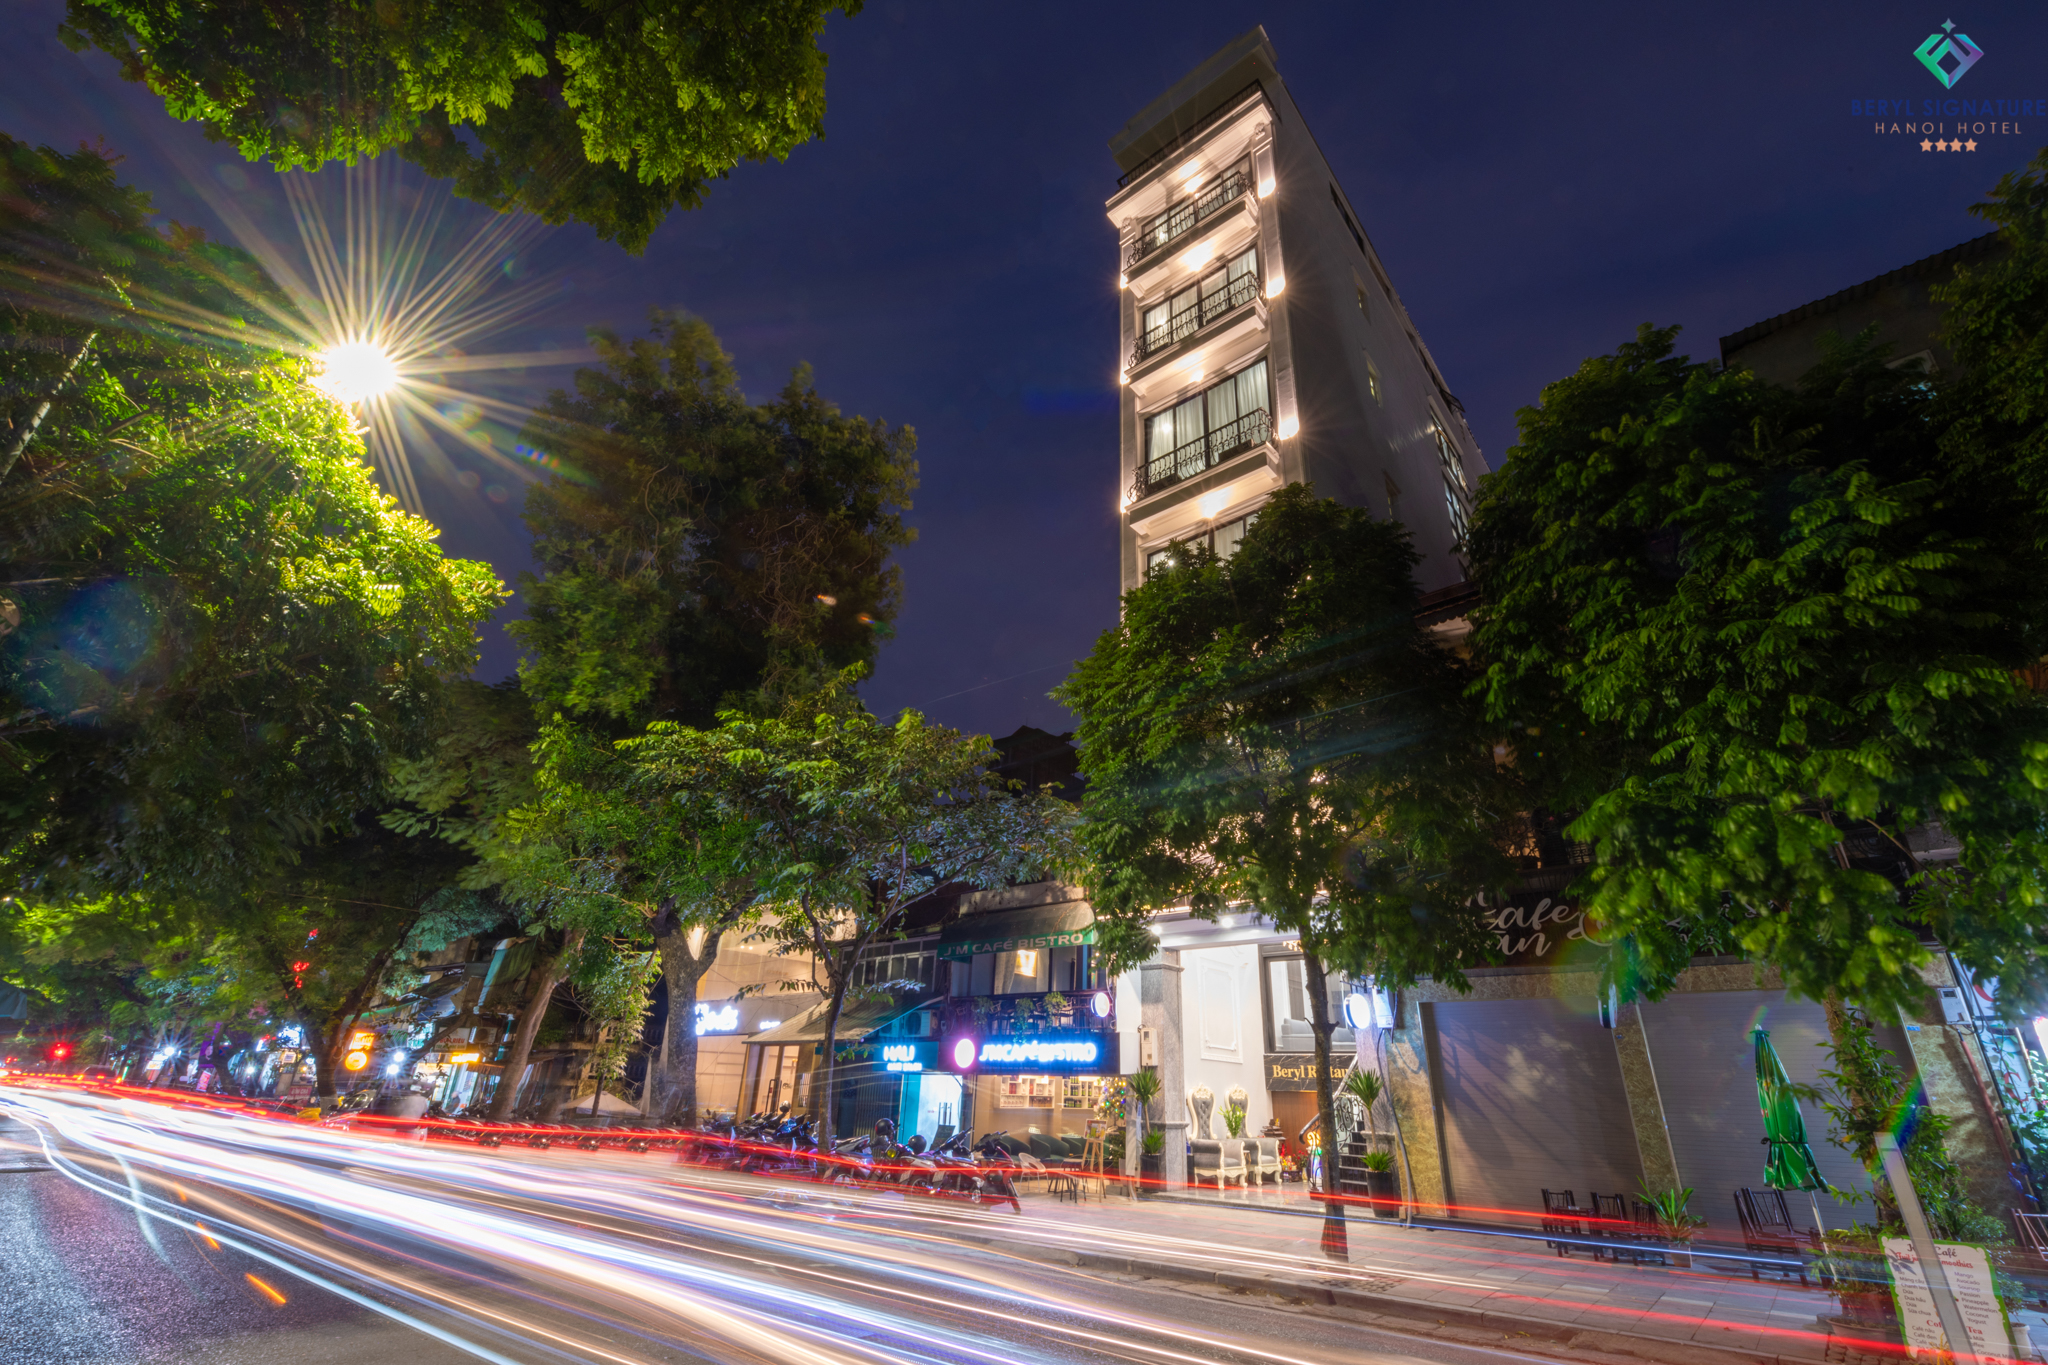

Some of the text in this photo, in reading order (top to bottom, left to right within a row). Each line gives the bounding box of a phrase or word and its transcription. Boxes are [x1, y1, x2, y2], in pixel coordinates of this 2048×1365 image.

[972, 938, 1013, 953] CAFÉ
[1018, 933, 1084, 949] BISTRO
[1272, 1064, 1305, 1081] Beryl
[1940, 1258, 1973, 1269] moothies
[1962, 1298, 1989, 1306] Pineapple
[1963, 1304, 1998, 1313] Watermelon
[1965, 1311, 1989, 1319] Coconut
[1966, 1326, 1983, 1334] Tea
